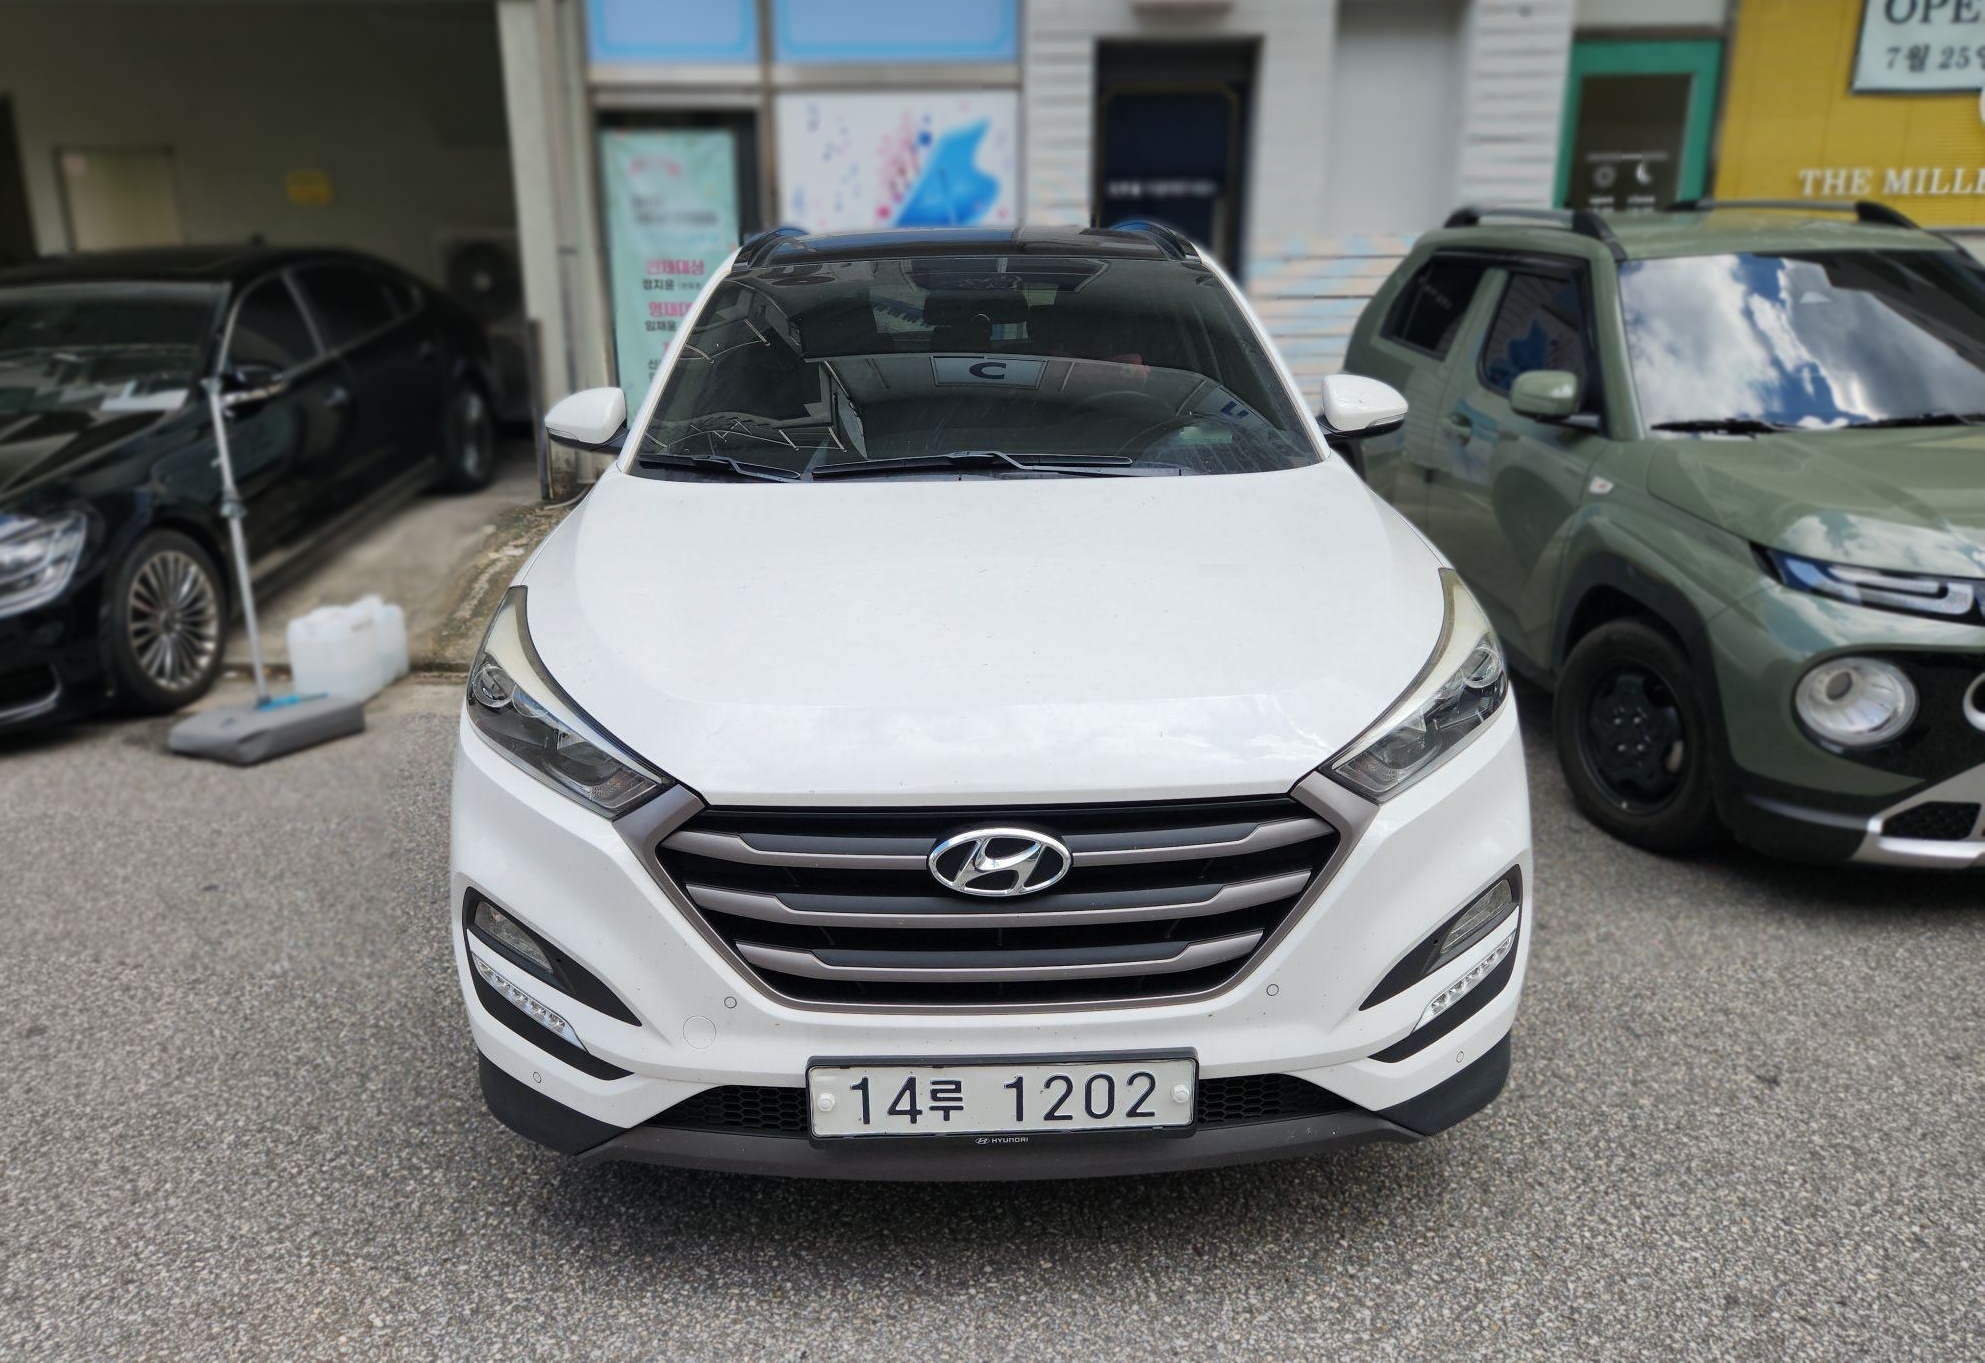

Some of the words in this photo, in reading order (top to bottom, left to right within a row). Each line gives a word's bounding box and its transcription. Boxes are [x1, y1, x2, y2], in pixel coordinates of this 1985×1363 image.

[1886, 43, 1931, 73] 7월
[1798, 167, 1873, 196] THE
[849, 1075, 964, 1124] 14루
[1003, 1071, 1156, 1122] 1202
[991, 1136, 1029, 1144] HYUNDAI
